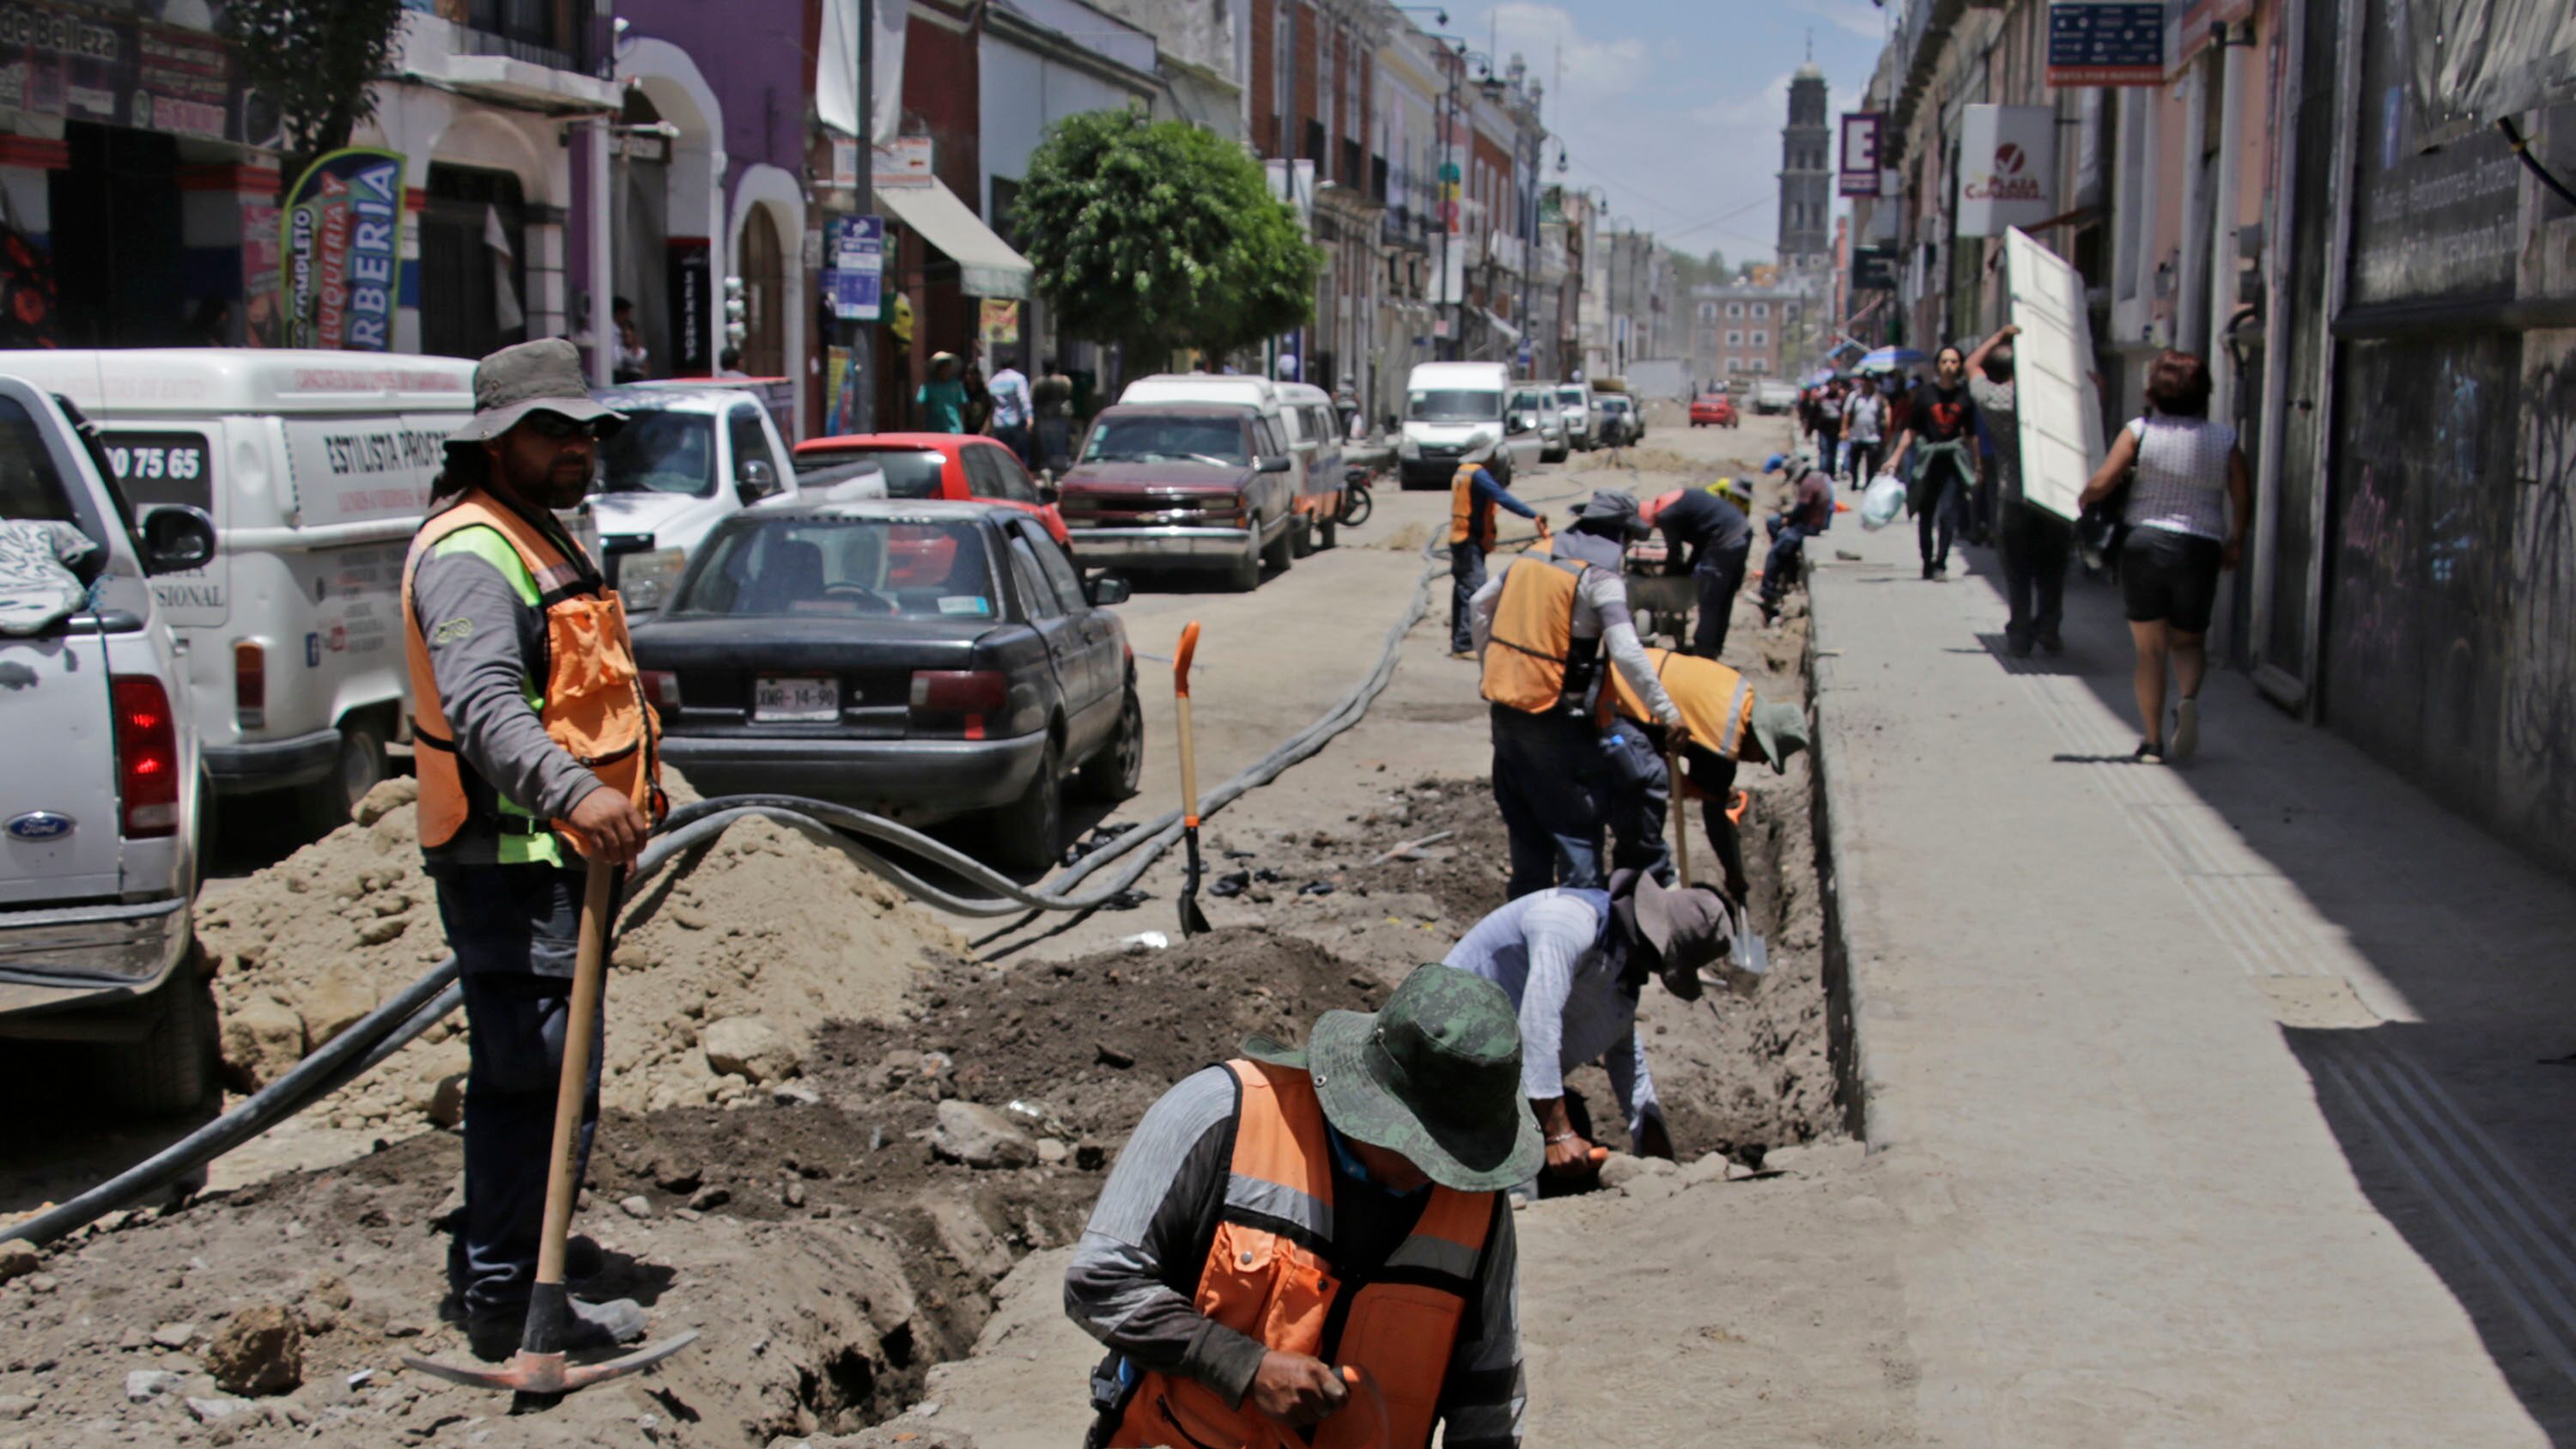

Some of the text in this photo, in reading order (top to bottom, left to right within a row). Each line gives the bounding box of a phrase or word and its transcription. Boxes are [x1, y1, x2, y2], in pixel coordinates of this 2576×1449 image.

[34, 9, 118, 62] Belleza
[323, 174, 344, 194] Y
[351, 165, 395, 347] RBERIA
[134, 447, 165, 478] 75
[168, 447, 199, 478] 65
[323, 430, 450, 473] ESTILISTA PROFE
[152, 585, 225, 607] SIONAL
